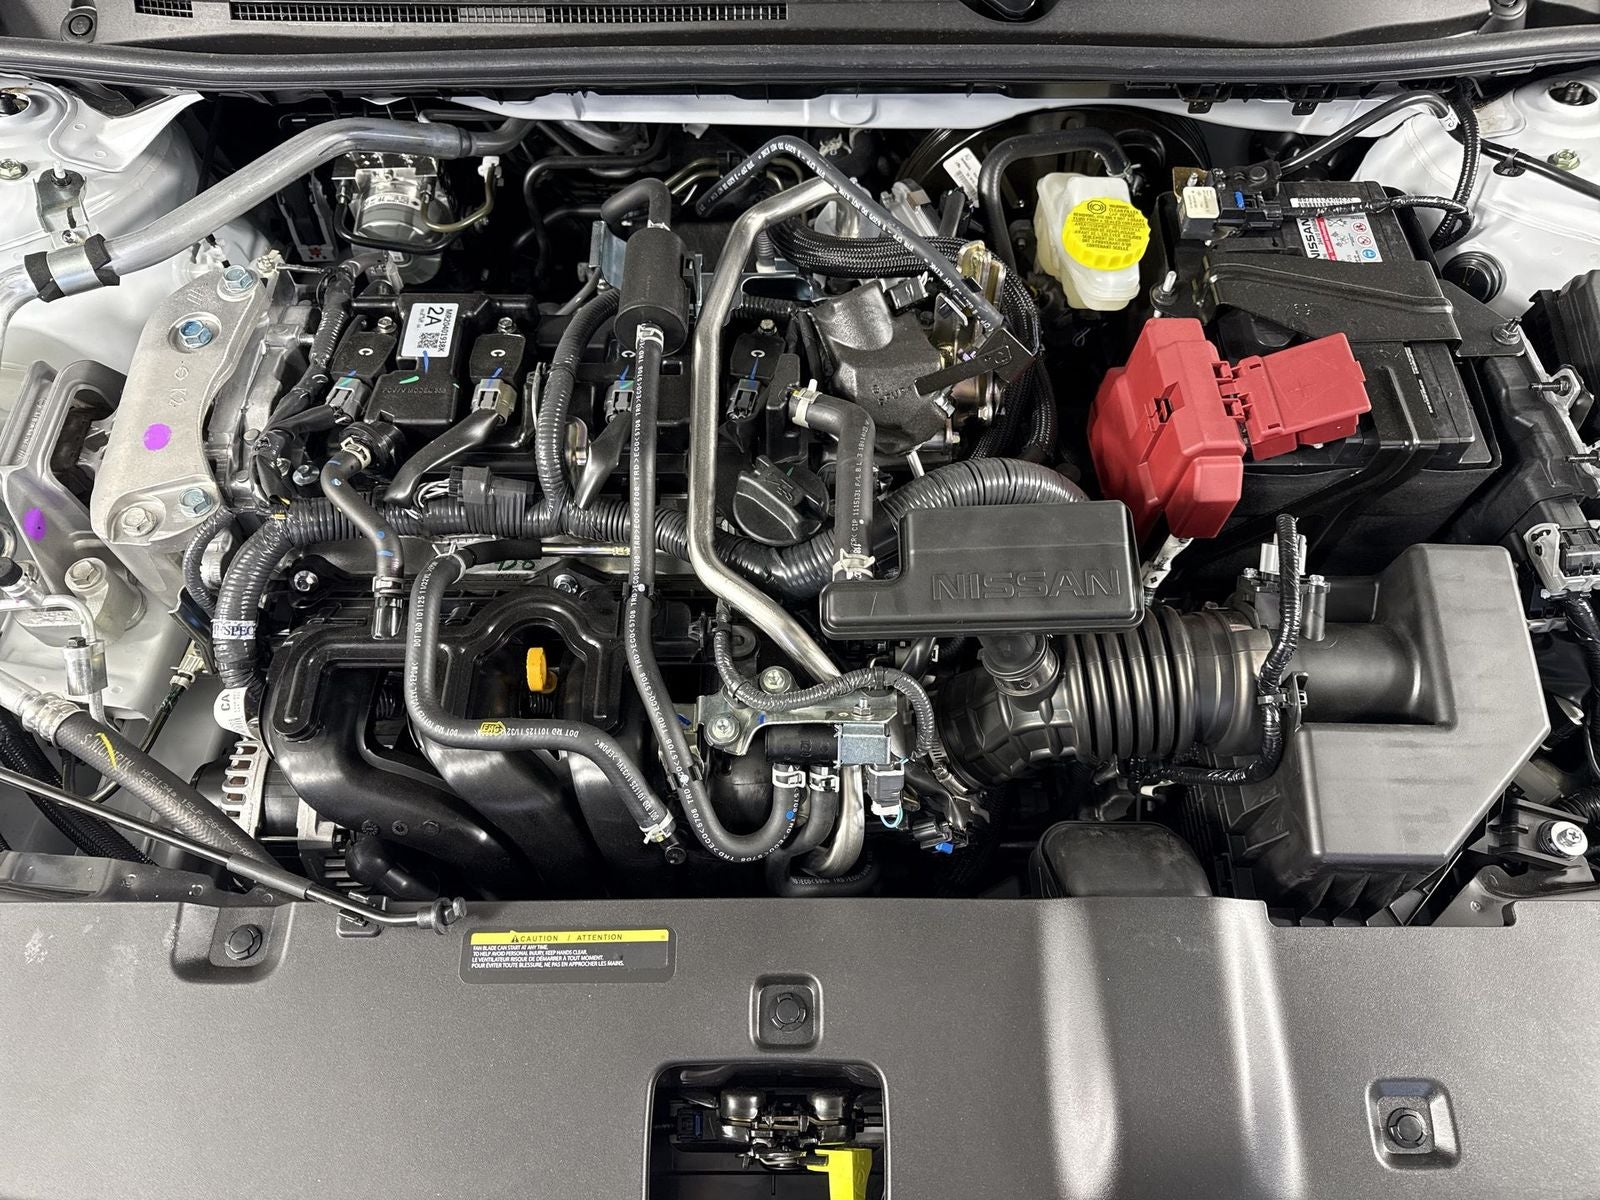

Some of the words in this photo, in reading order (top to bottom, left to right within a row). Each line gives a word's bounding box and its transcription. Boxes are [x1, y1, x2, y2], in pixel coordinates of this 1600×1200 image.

[424, 306, 445, 327] 2A
[931, 568, 1121, 600] NISSAN
[220, 694, 231, 712] CA
[576, 933, 623, 941] ATTENTION
